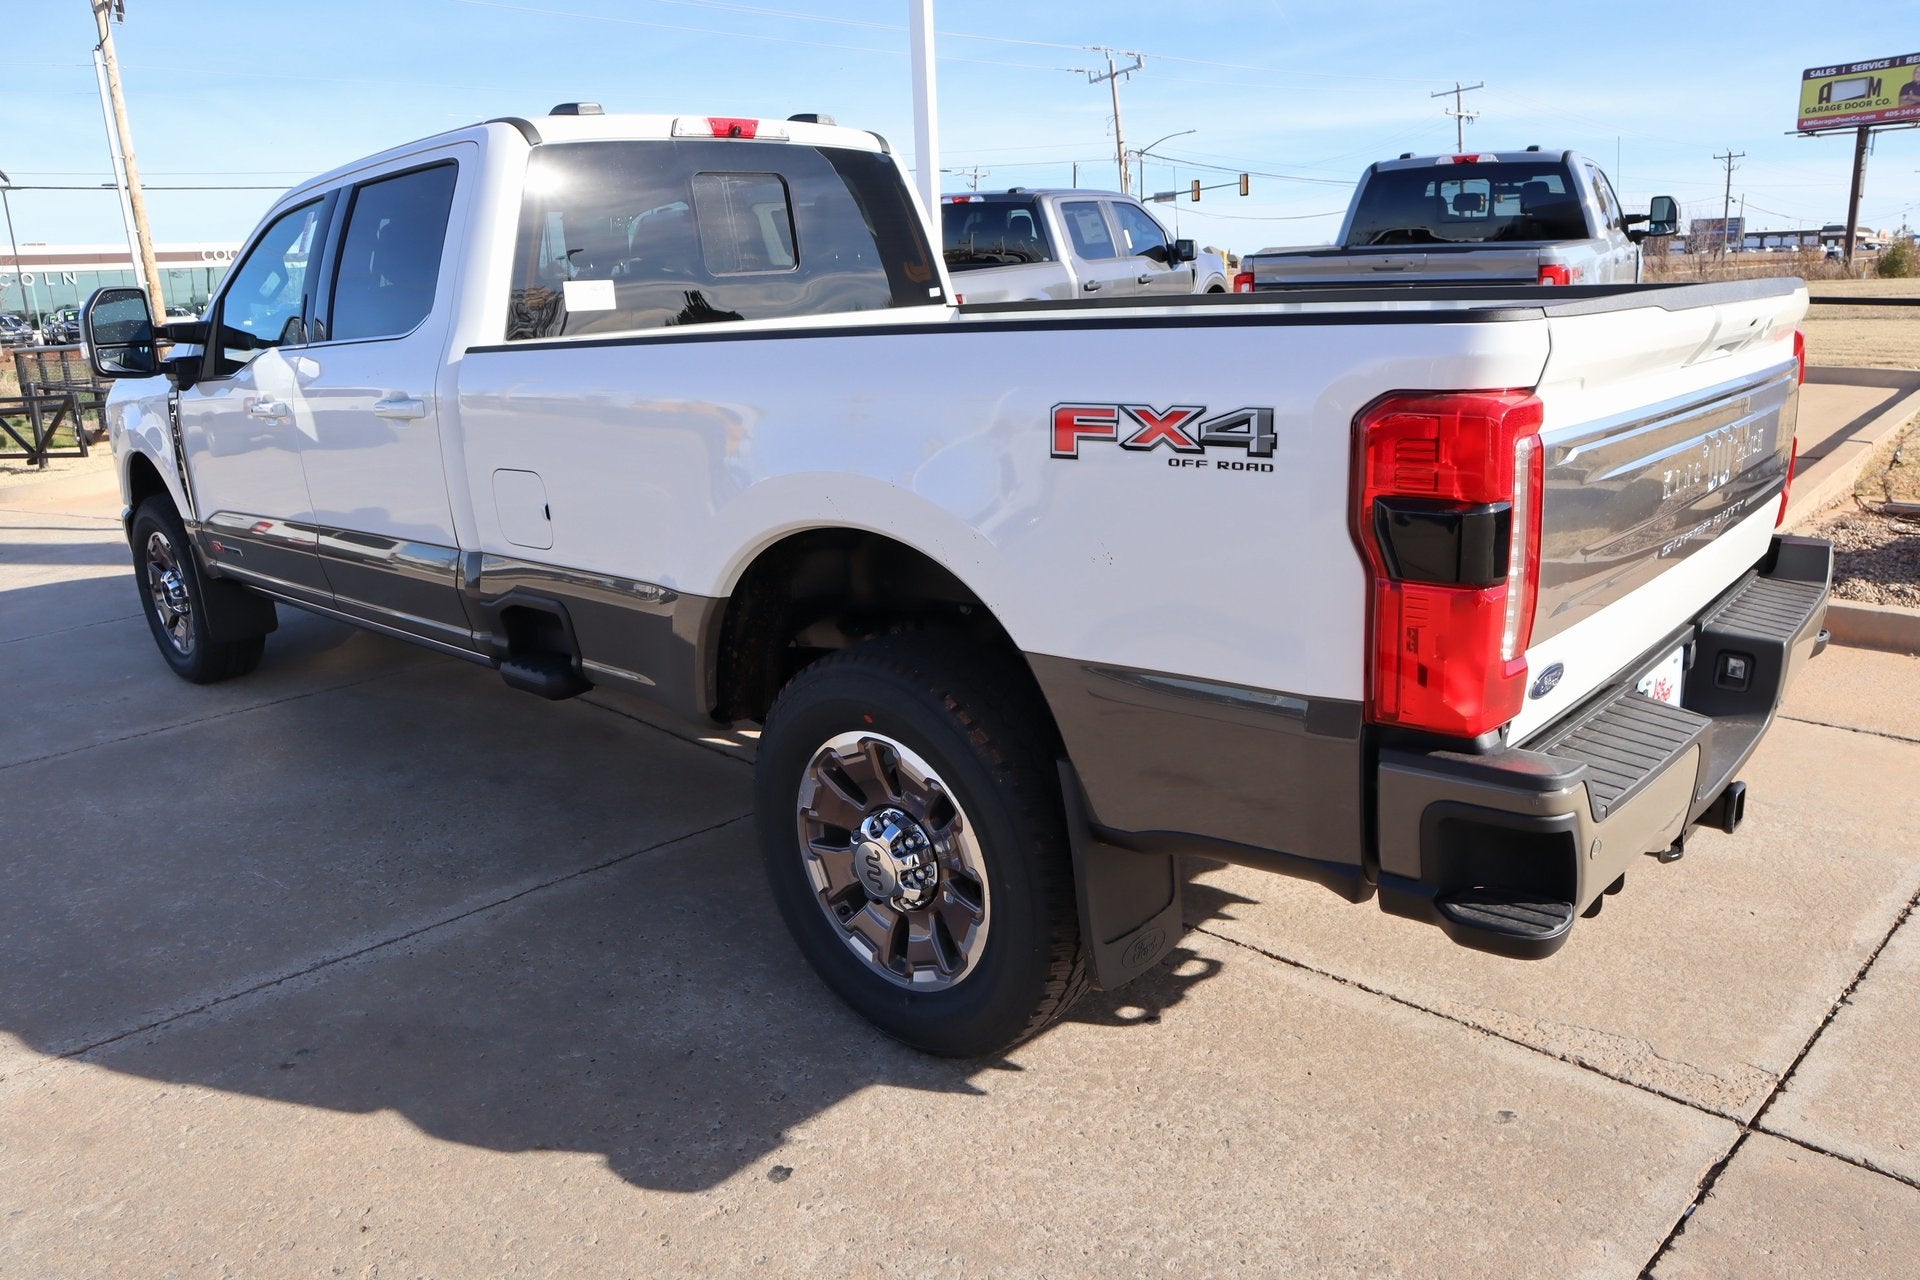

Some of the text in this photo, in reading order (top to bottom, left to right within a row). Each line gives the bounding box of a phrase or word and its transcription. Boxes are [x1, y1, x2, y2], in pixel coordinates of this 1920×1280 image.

[1810, 68, 1837, 78] SALES
[1851, 60, 1890, 72] SERVICE
[1805, 103, 1842, 114] GARAGE
[1844, 100, 1872, 110] DOOR
[1051, 402, 1277, 459] FX4
[1168, 458, 1274, 473] OFF ROAD
